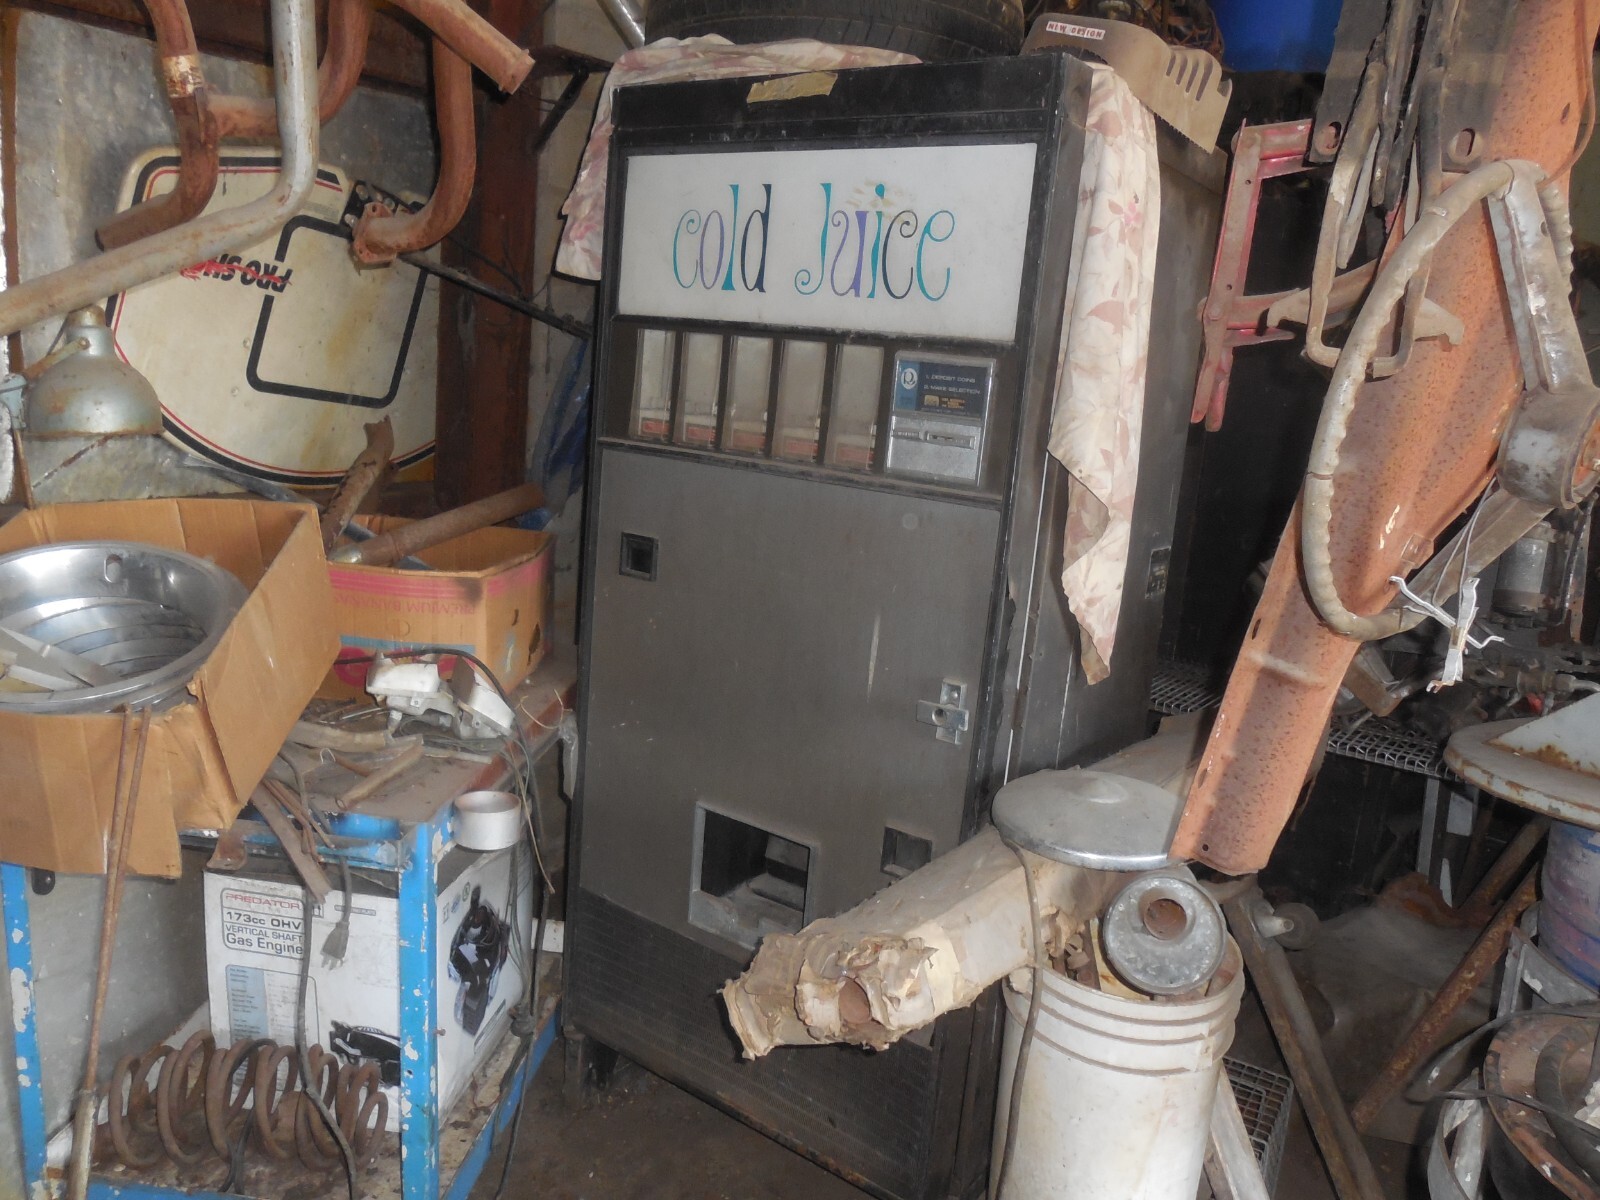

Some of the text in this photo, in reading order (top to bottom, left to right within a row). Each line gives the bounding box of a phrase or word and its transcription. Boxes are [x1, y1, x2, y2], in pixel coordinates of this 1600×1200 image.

[1047, 23, 1102, 38] NEW DESIGN
[672, 182, 955, 301] cold Juice
[241, 260, 293, 292] PRO
[406, 600, 476, 615] PREMIUM
[225, 893, 300, 910] PREDATOR
[226, 911, 302, 930] 173cc OHV
[225, 924, 303, 943] VERTICAL SHAFT
[226, 932, 303, 955] Gas Engine
